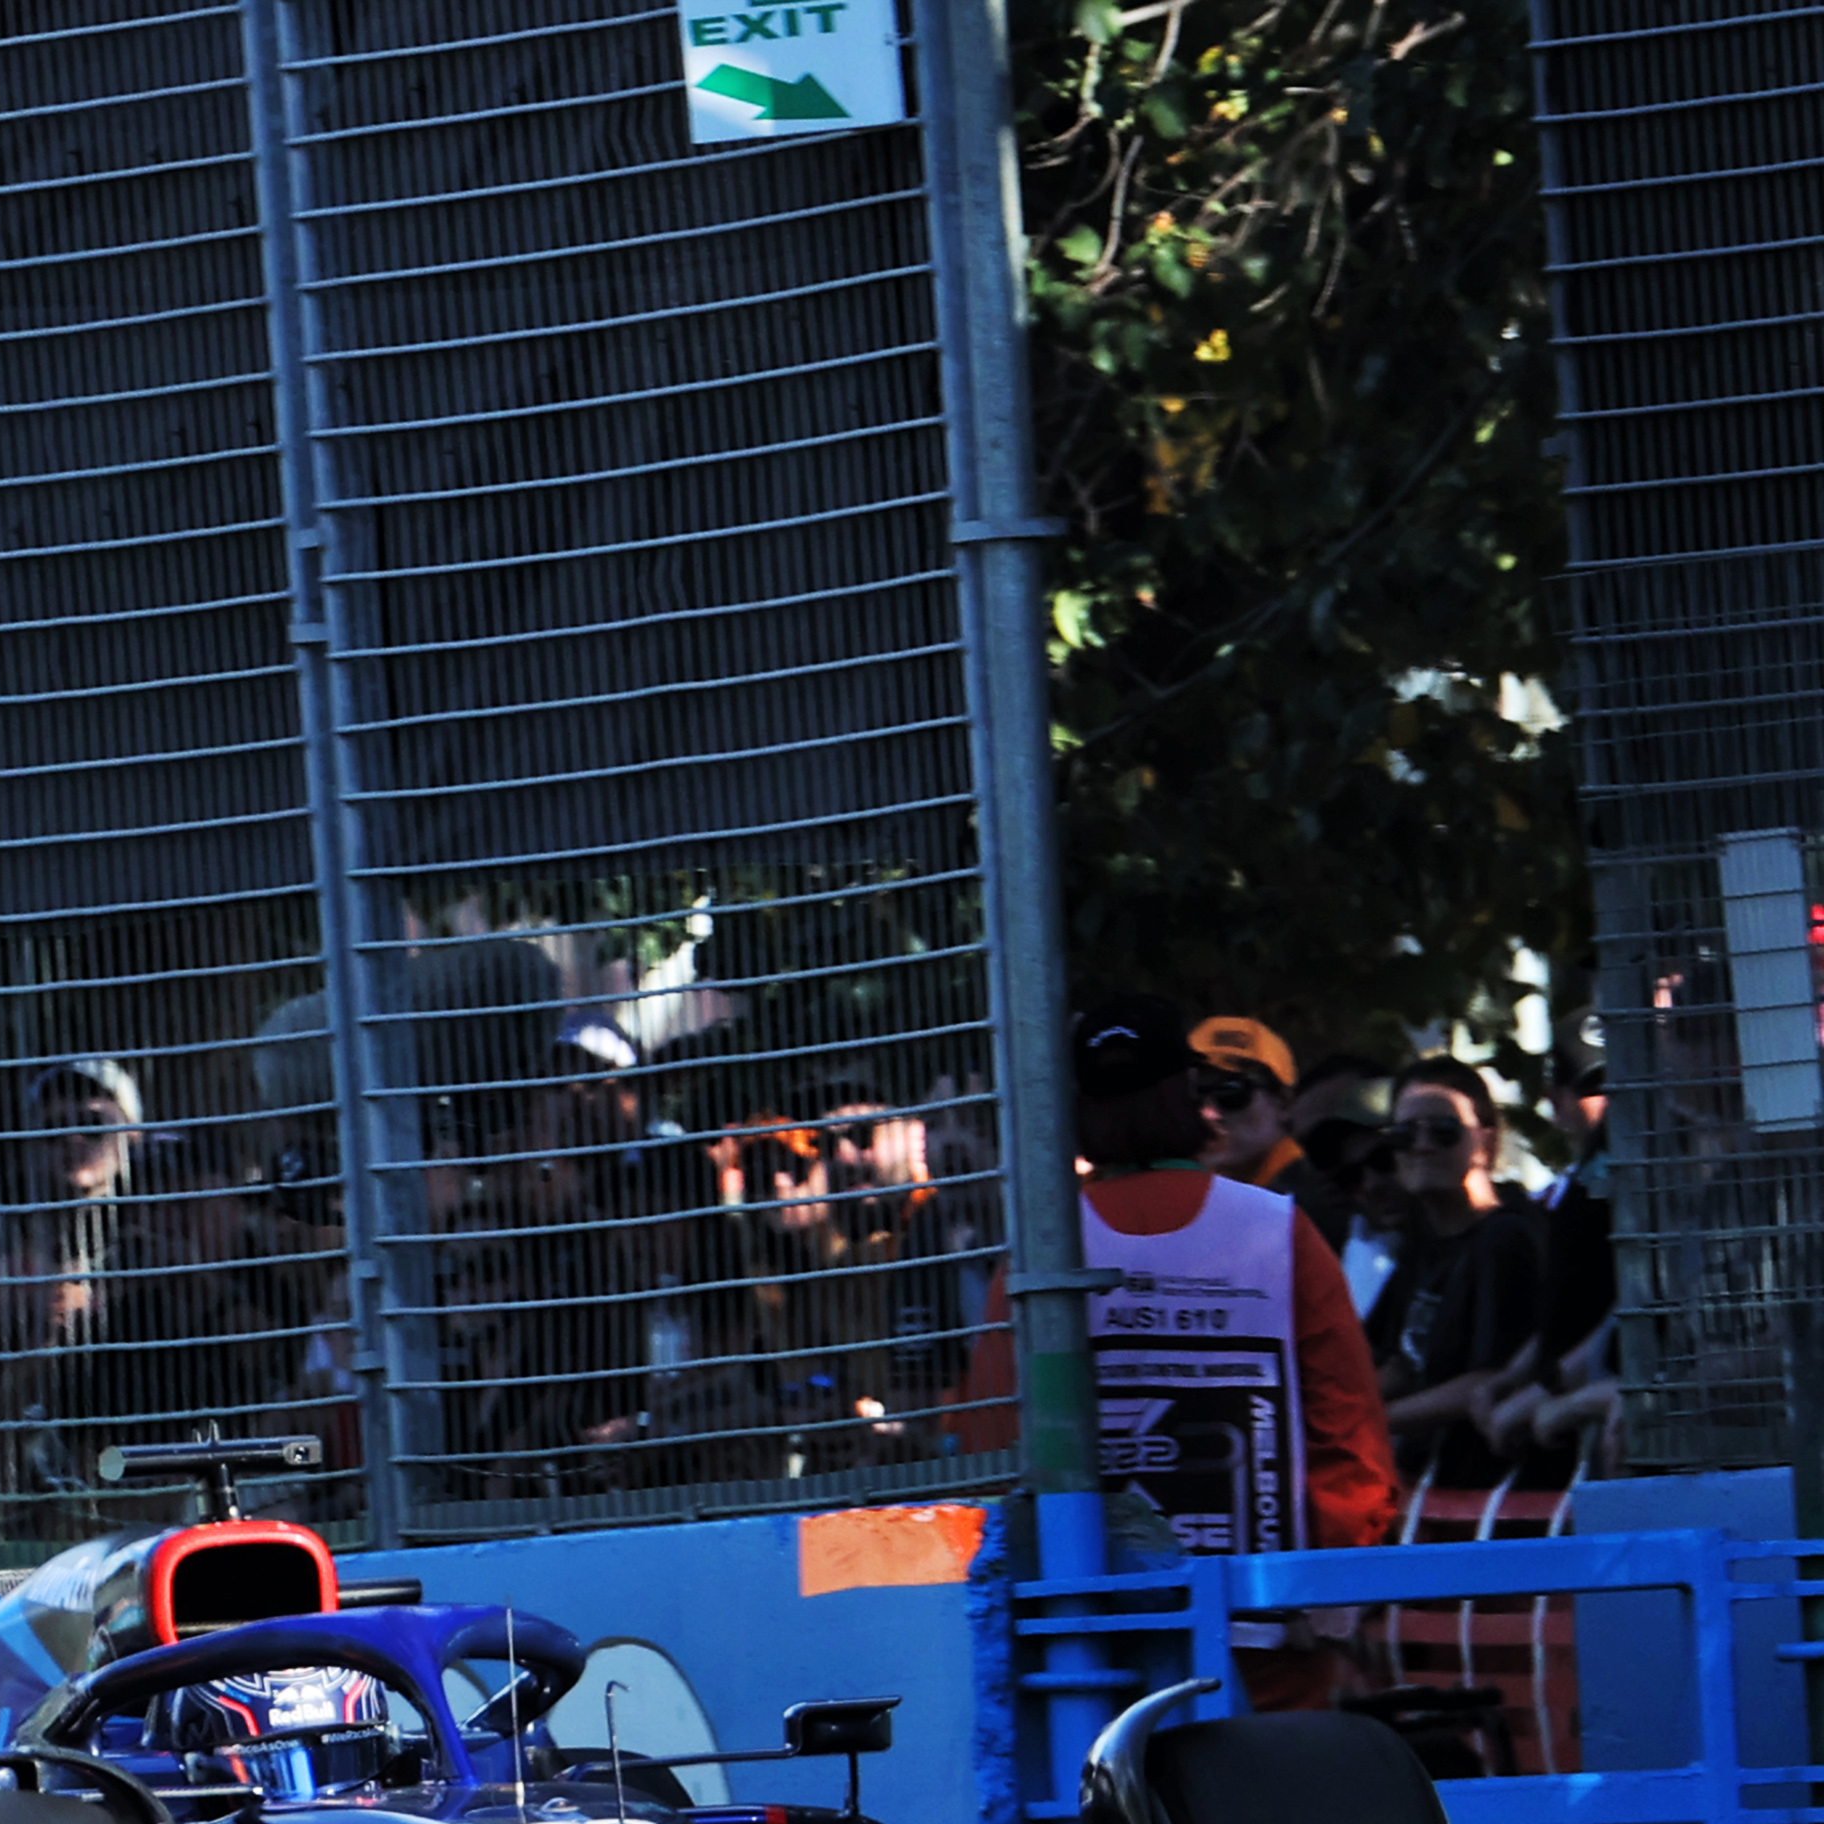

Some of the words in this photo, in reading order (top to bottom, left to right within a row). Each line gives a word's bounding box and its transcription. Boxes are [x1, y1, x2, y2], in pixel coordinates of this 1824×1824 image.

[690, 3, 847, 46] EXIT
[1250, 1394, 1281, 1550] MELBOU
[268, 1703, 302, 1727] Red
[303, 1700, 336, 1723] Bull
